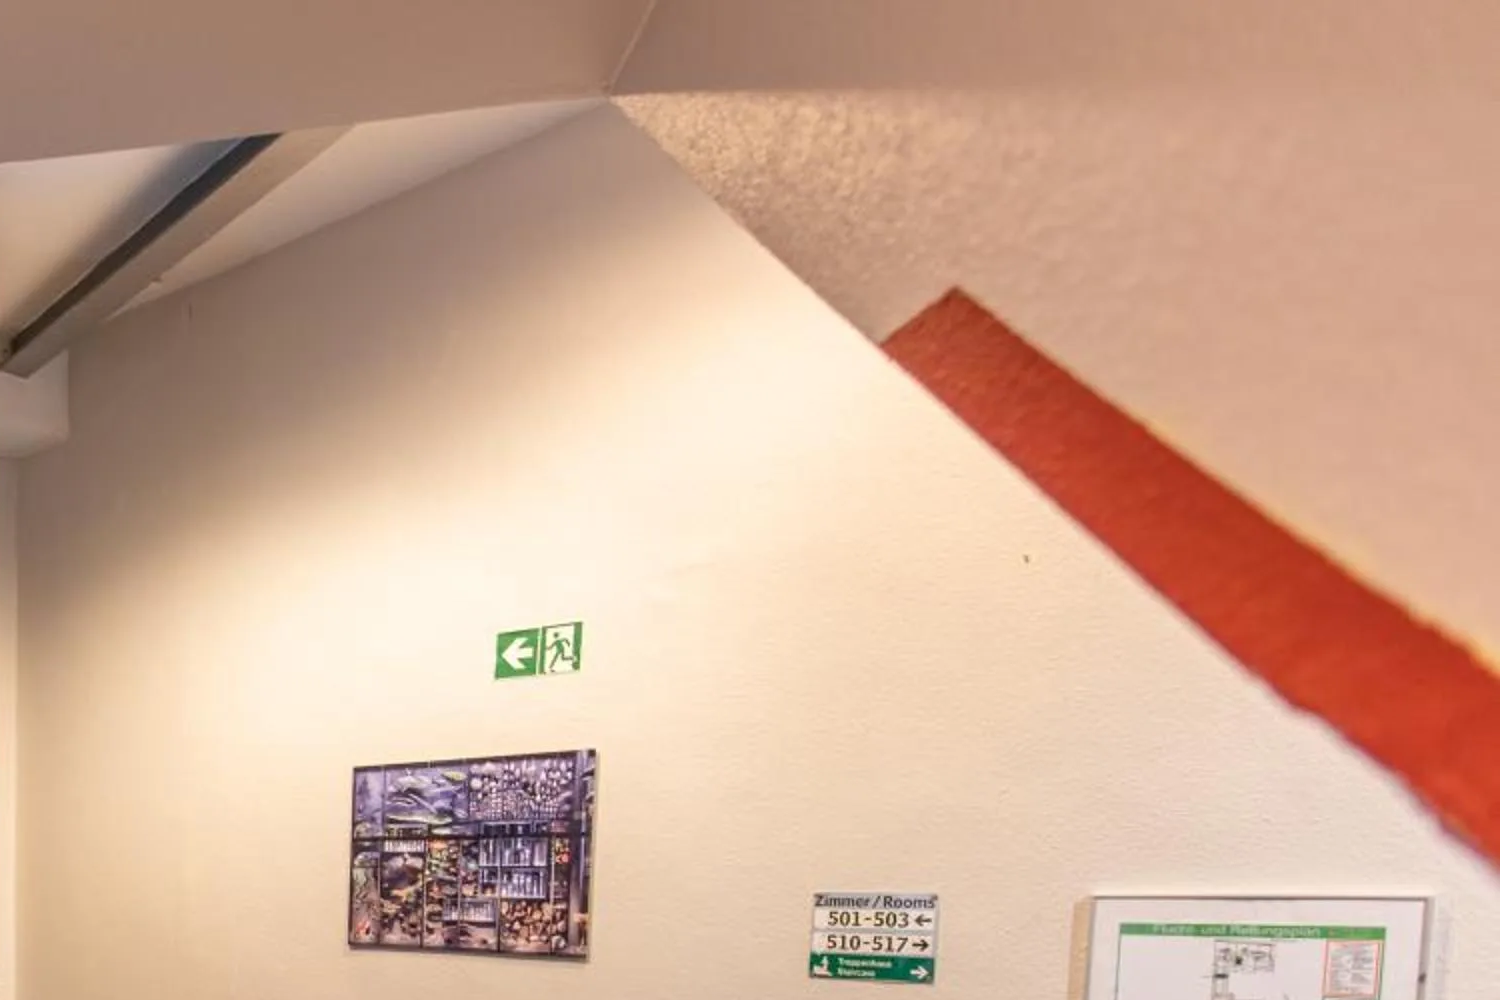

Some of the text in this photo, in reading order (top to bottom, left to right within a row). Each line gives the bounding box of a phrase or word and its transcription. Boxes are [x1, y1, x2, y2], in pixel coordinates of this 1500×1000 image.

[814, 895, 936, 909] Zimmer/Rooms
[827, 911, 910, 928] 501-503
[826, 934, 909, 952] 510-517
